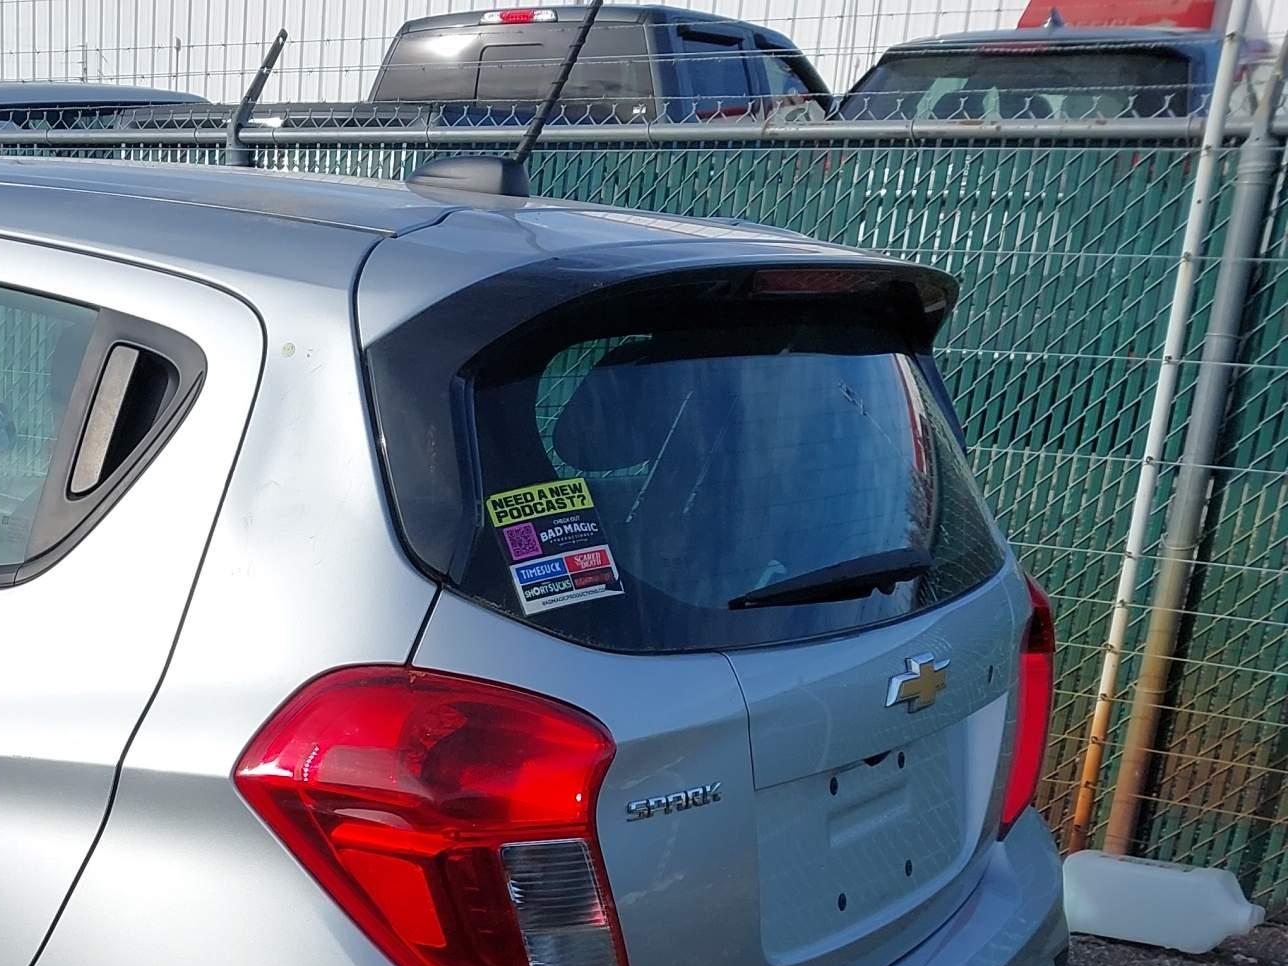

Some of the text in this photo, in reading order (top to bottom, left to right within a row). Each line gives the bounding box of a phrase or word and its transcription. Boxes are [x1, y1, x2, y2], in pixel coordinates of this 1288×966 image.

[492, 482, 583, 511] NEED A NEW
[495, 495, 587, 523] PODCAST?
[540, 527, 563, 542] BAD
[563, 522, 598, 535] MAGIC
[521, 563, 562, 580] TIMESUCK
[626, 781, 721, 822] SPARK
